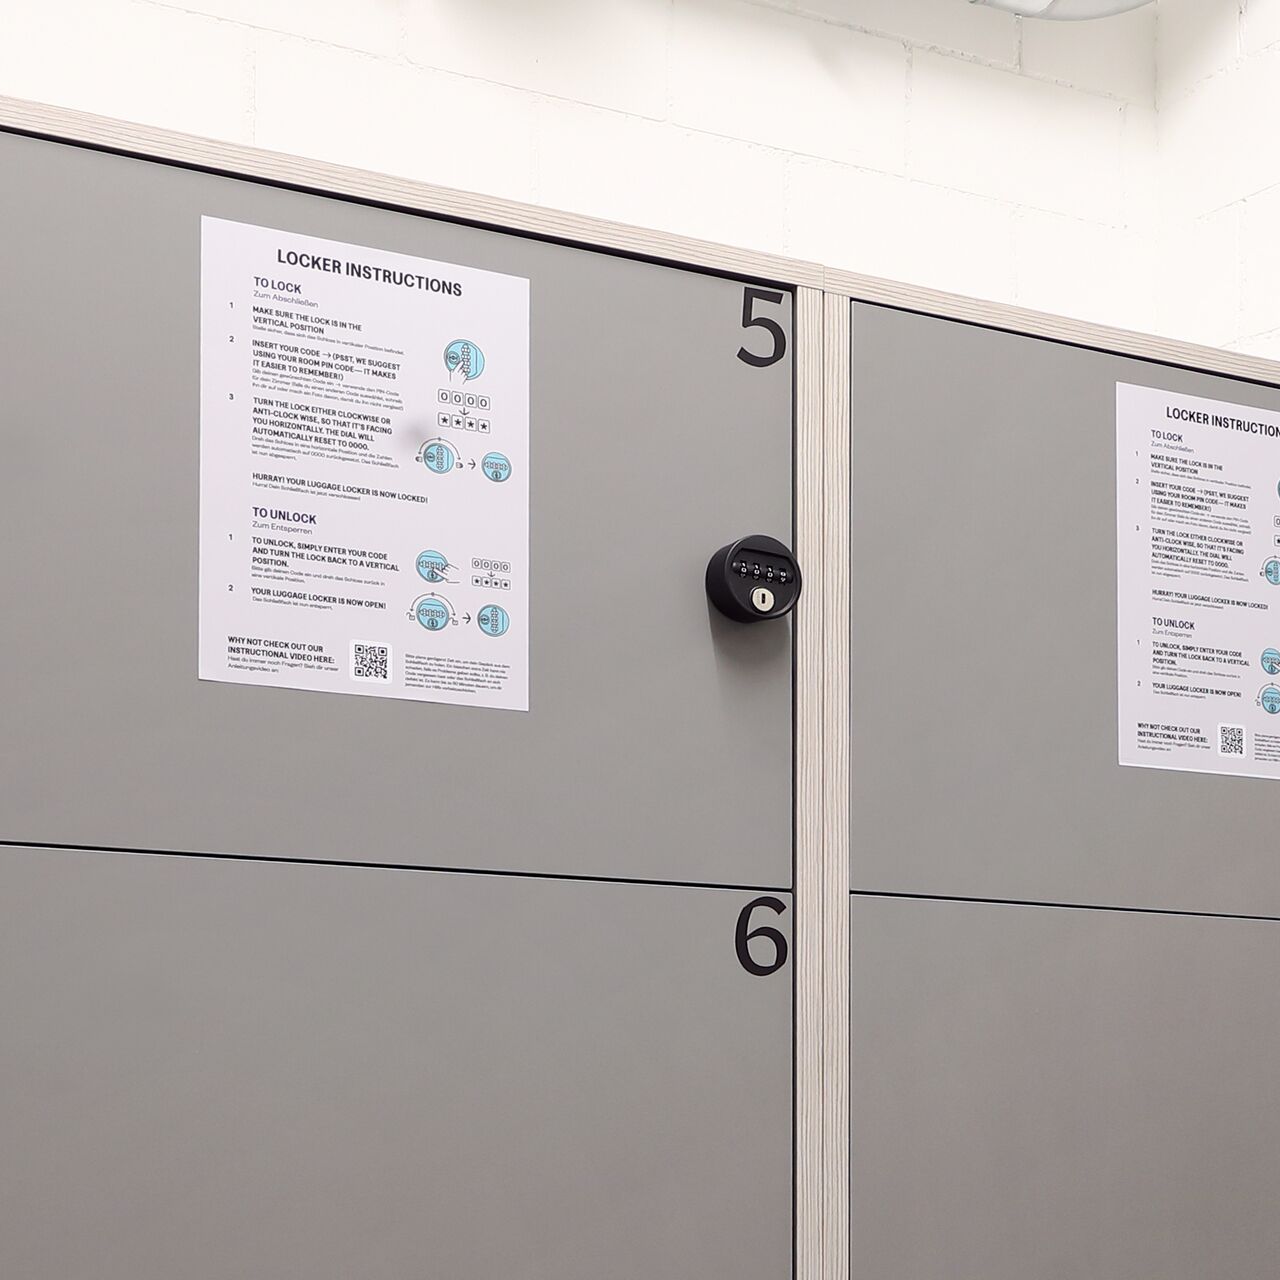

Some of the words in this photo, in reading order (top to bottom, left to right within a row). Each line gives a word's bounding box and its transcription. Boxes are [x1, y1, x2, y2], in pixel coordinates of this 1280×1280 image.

[277, 248, 341, 274] LOCKER
[345, 261, 462, 296] INSTRUCTIONS
[253, 276, 269, 288] TO
[271, 279, 301, 294] LOCK
[253, 289, 270, 299] Zum
[252, 305, 273, 315] MAKE
[275, 309, 293, 319] SURE
[295, 313, 308, 322] THE
[310, 316, 330, 325] LOCK
[331, 319, 338, 327] IS
[348, 322, 361, 331] THE
[252, 315, 288, 328] VERTICAL
[289, 322, 324, 334] POSITION
[737, 286, 786, 367] 5
[252, 339, 278, 350] INSERT
[279, 343, 298, 353] YOUR
[299, 347, 320, 357] CODE
[355, 357, 366, 365] WE
[367, 358, 400, 370] SUGGEST
[252, 349, 276, 359] USING
[277, 353, 296, 363] YOUR
[298, 356, 320, 366] ROOM
[321, 360, 333, 368] PIN
[371, 369, 396, 379] MAKES
[261, 360, 286, 371] EASIER
[288, 365, 298, 373] TO
[252, 406, 298, 420] ANTI-CLOCK
[321, 417, 331, 425] SO
[332, 419, 350, 428] THAT
[366, 424, 392, 434] FACING
[253, 397, 273, 406] TURN
[275, 400, 288, 408] THE
[290, 402, 310, 412] LOCK
[311, 406, 336, 416] EITHER
[337, 410, 379, 423] CLOCKWISE
[380, 417, 390, 425] OR
[1166, 406, 1209, 425] LOCKER
[252, 416, 267, 425] YOU
[325, 428, 338, 436] THE
[340, 430, 356, 438] DIAL
[357, 433, 374, 441] WILL
[252, 426, 313, 442] AUTOMATICALLY
[314, 435, 336, 445] RESET
[337, 439, 347, 447] TO
[1151, 429, 1161, 439] TO
[1162, 431, 1182, 442] LOCK
[252, 472, 284, 483] HURRAY!
[286, 477, 305, 486] YOUR
[307, 480, 341, 491] LUGGAGE
[342, 485, 370, 495] LOCKER
[379, 490, 396, 498] NOW
[397, 493, 427, 503] LOCKED!
[252, 506, 267, 518] TO
[270, 509, 316, 524] UNLOCK
[252, 520, 269, 529] Zum
[252, 536, 262, 544] TO
[297, 542, 322, 552] SIMPLY
[323, 545, 346, 555] ENTER
[347, 548, 366, 557] YOUR
[367, 551, 387, 560] CODE
[252, 546, 268, 555] AND
[269, 548, 289, 557] TURN
[291, 551, 304, 559] THE
[306, 553, 326, 562] LOCK
[327, 556, 347, 564] BACK
[348, 558, 358, 566] TO
[365, 560, 399, 571] VERTICAL
[251, 587, 271, 596] YOUR
[272, 589, 306, 600] LUGGAGE
[308, 593, 336, 603] LOCKER
[346, 598, 363, 606] NOW
[364, 600, 385, 609] OPEN!
[1152, 616, 1162, 626] TO
[1163, 618, 1194, 630] UNLOCK
[227, 636, 245, 644] WHY
[246, 637, 262, 646] NOT
[263, 639, 289, 649] CHECK
[290, 642, 306, 650] OUT
[307, 644, 323, 652] OUR
[227, 645, 288, 659] INSTRUCTIONAL
[289, 652, 312, 661] VIDEO
[735, 896, 788, 976] 6
